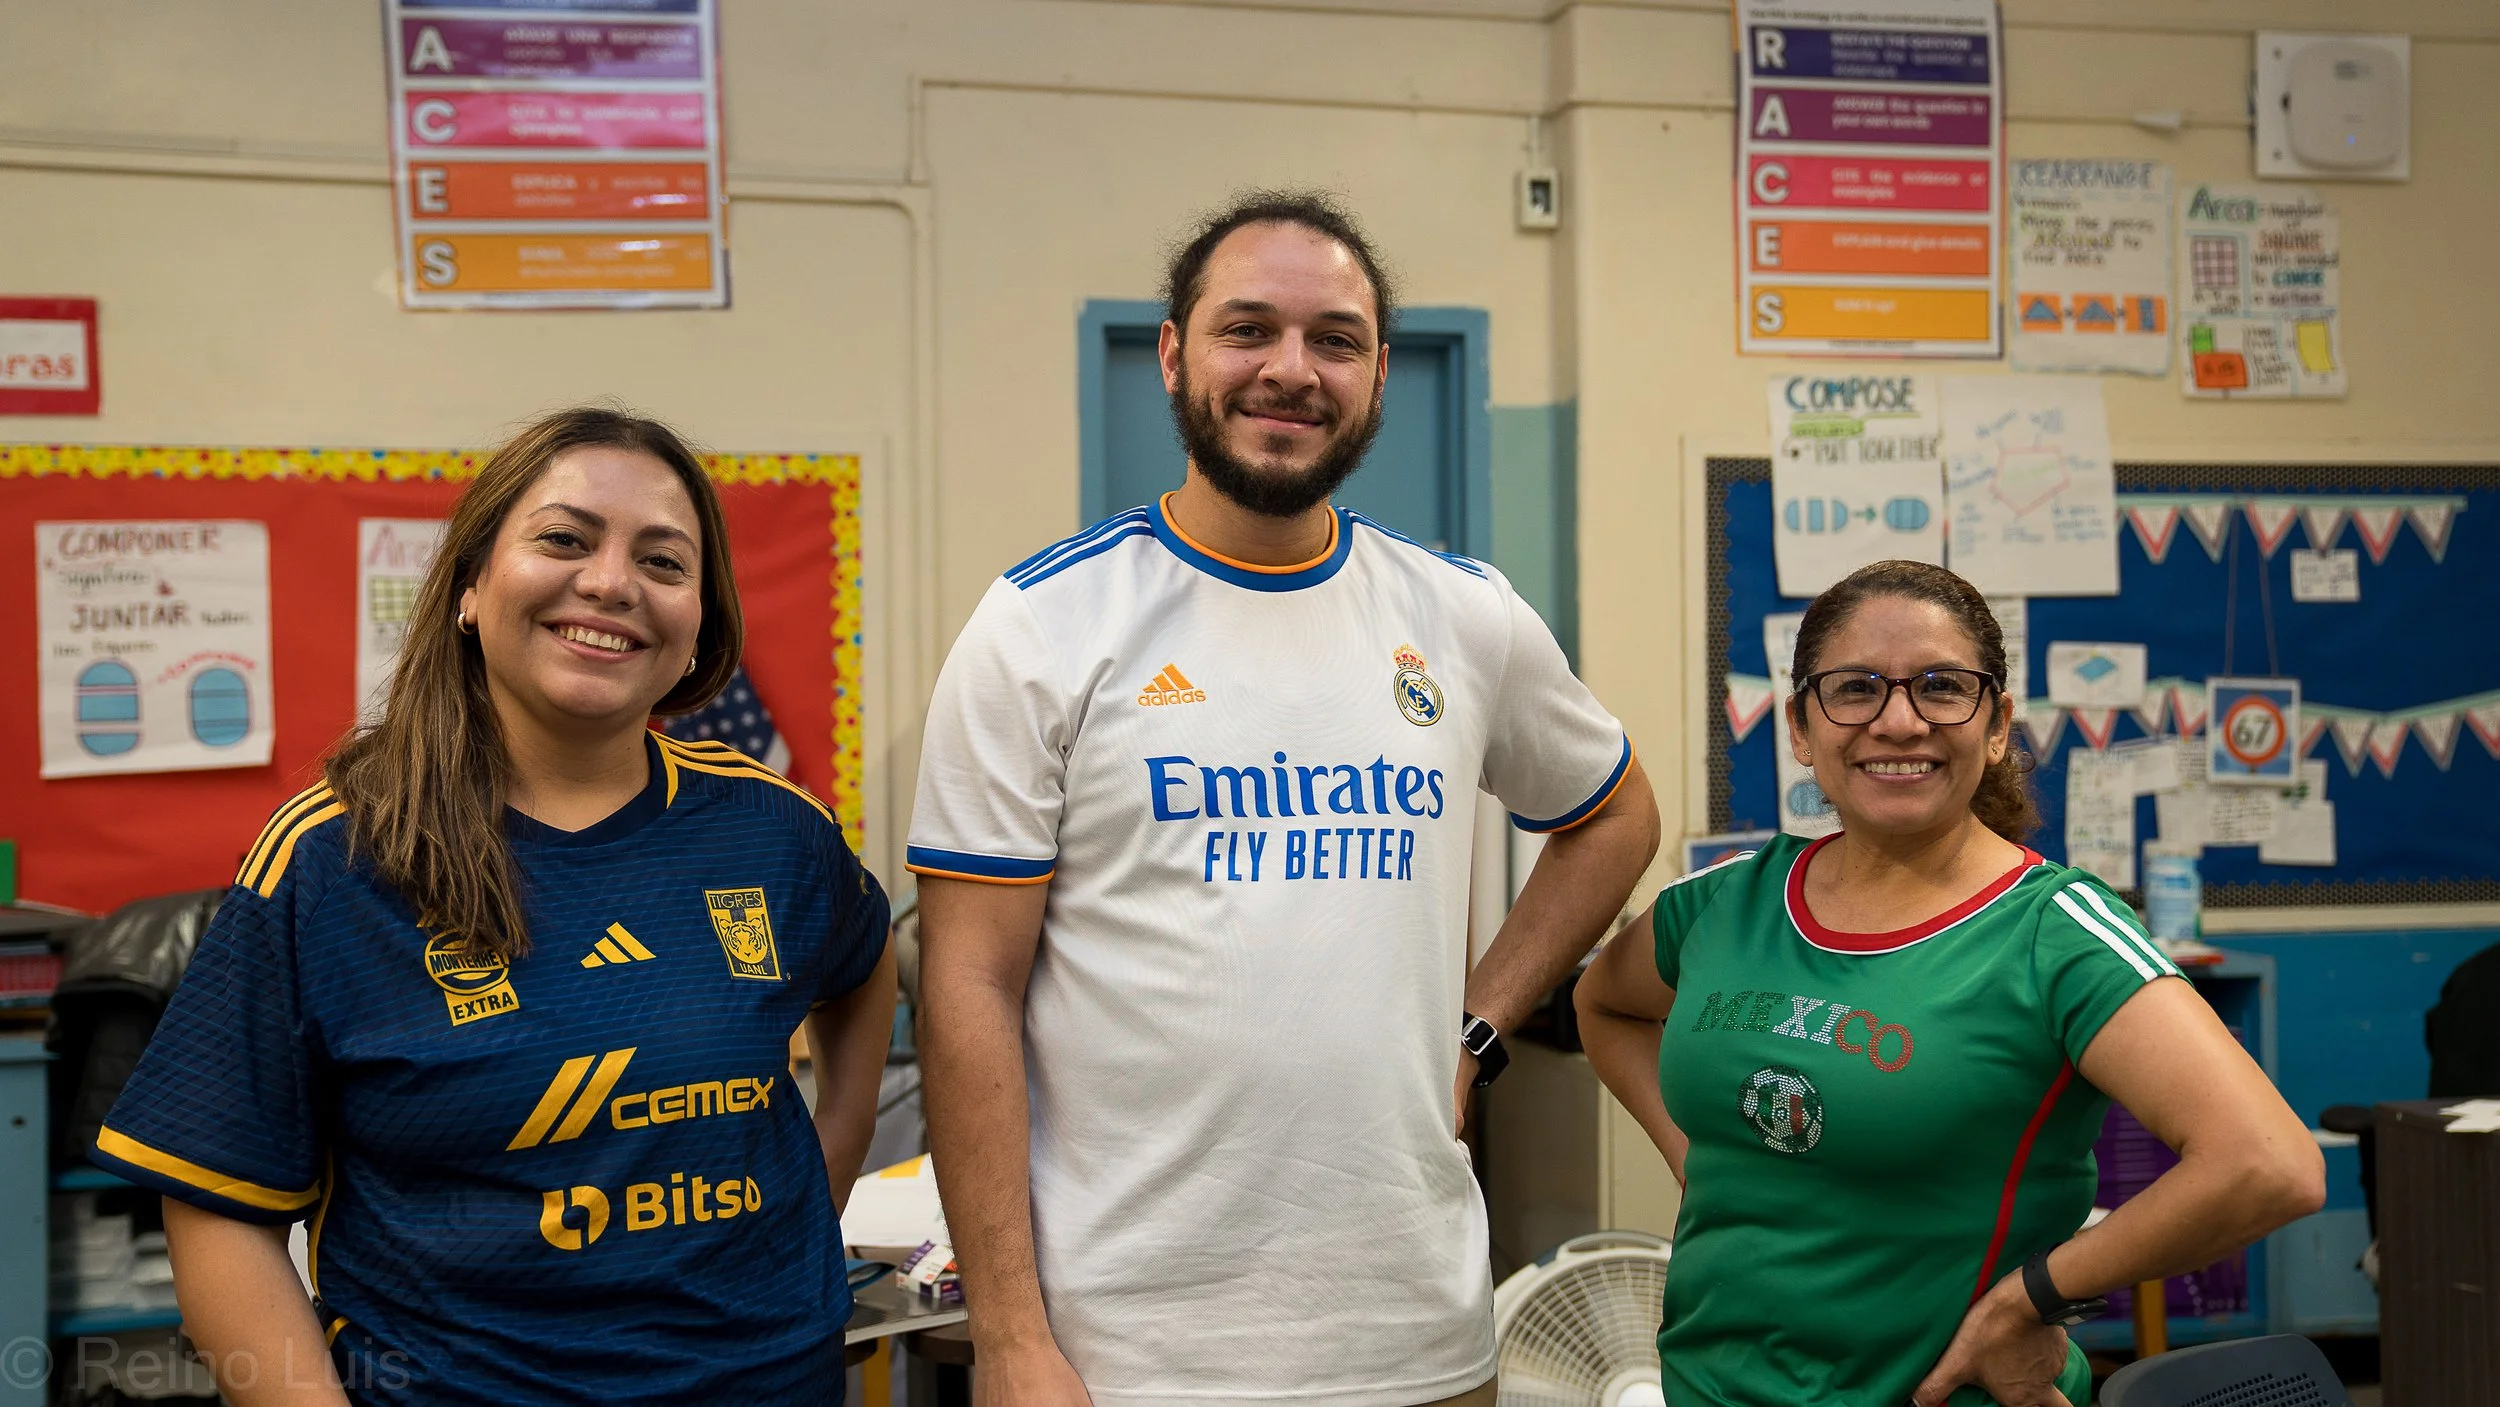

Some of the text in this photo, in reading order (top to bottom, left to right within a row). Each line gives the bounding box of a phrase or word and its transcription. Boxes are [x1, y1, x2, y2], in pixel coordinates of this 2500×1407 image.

[411, 26, 452, 71] A
[1755, 30, 1786, 69] R
[412, 99, 457, 142] C
[1755, 95, 1789, 136] A
[416, 169, 449, 213] E
[1754, 163, 1789, 203] C
[2187, 186, 2257, 222] Area
[421, 241, 458, 286] S
[1756, 227, 1781, 266] E
[1757, 292, 1785, 332] S
[0, 353, 76, 380] ras
[1785, 375, 1915, 412] COMPOSE
[1814, 437, 1849, 464] PUT
[1857, 433, 1939, 463] TOGETHER
[58, 526, 222, 560] COMPONER
[69, 602, 192, 634] JUNTAR
[1138, 686, 1206, 707] adidas
[2232, 714, 2272, 749] 67
[1144, 751, 1444, 821] Emirates
[1204, 828, 1415, 883] FLY BETTER
[710, 892, 762, 909] TIGRES
[740, 963, 768, 976] UANL
[453, 991, 515, 1020] EXTRA
[1692, 990, 1914, 1073] MEXICO
[611, 1077, 774, 1131] CEMEX
[626, 1172, 761, 1232] Bitso
